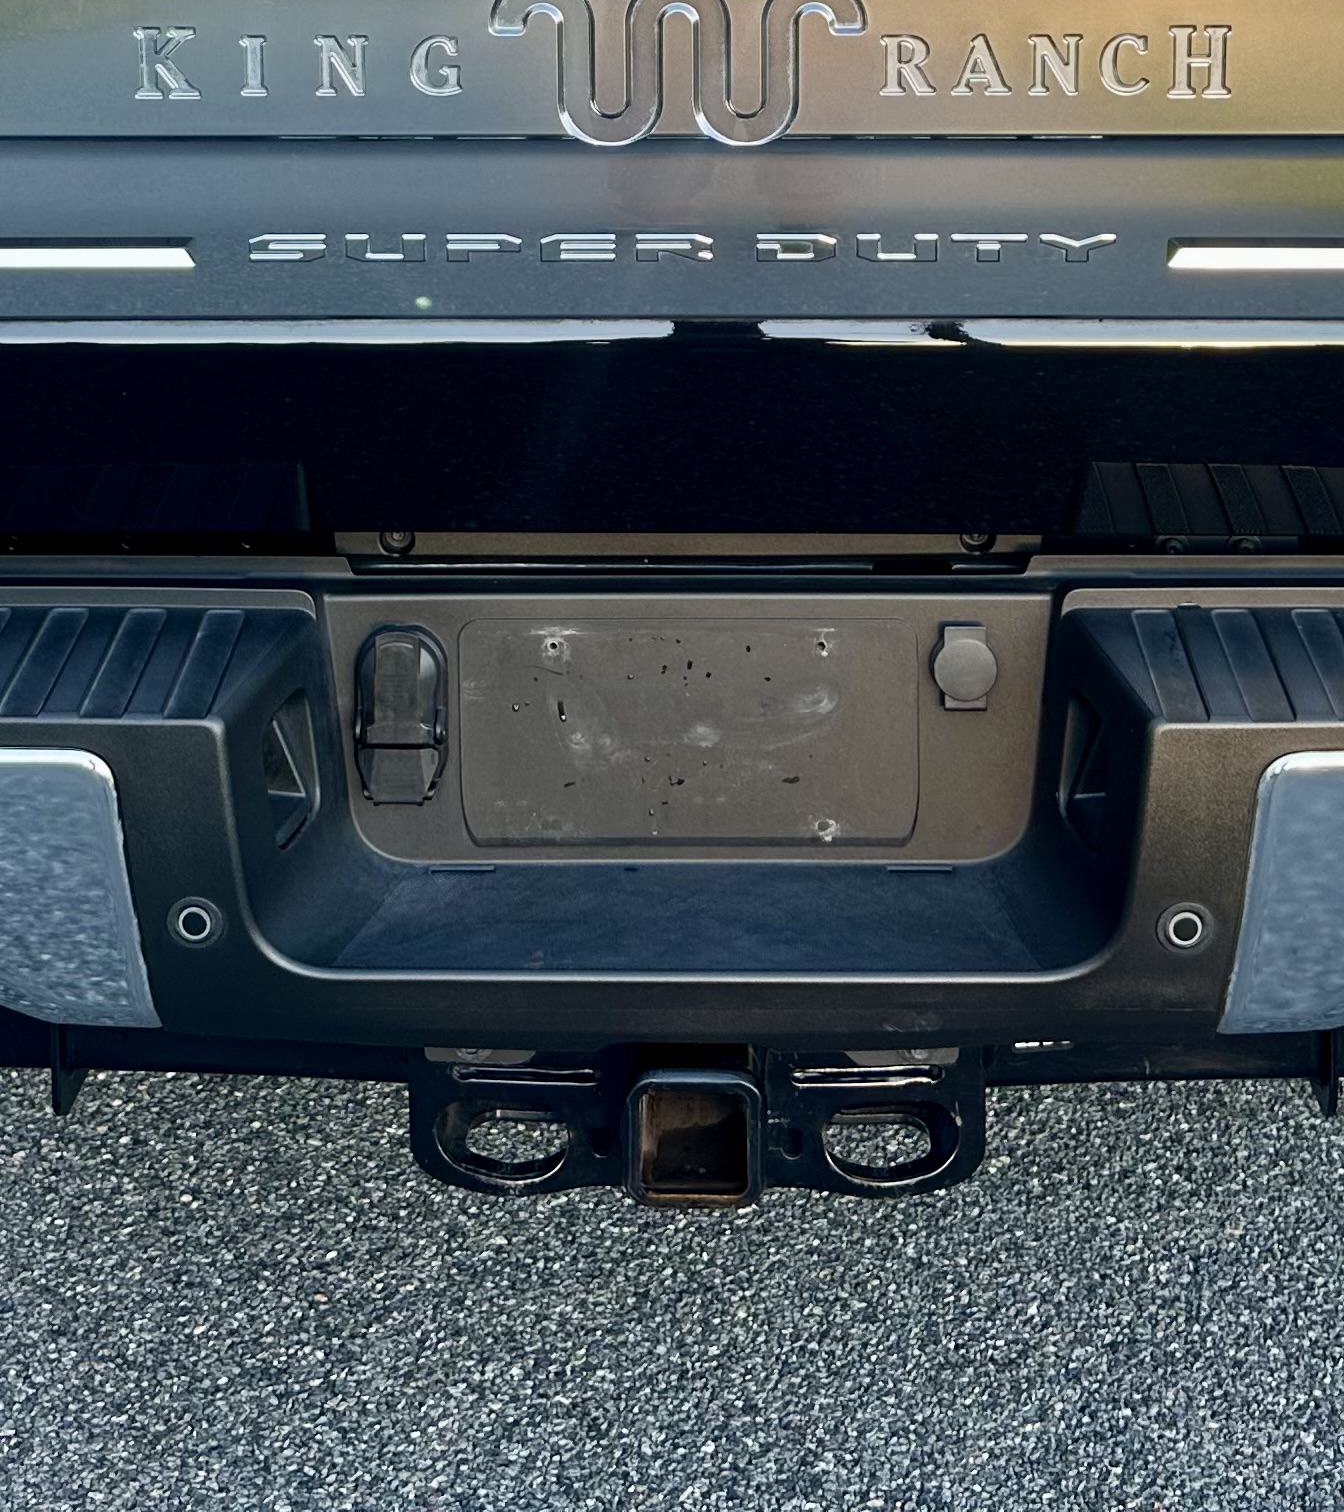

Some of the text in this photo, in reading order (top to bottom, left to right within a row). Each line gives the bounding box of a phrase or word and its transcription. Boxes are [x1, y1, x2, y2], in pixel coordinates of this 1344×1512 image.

[132, 24, 1234, 101] KING RANCH
[247, 232, 1118, 263] SUPER DUTY
